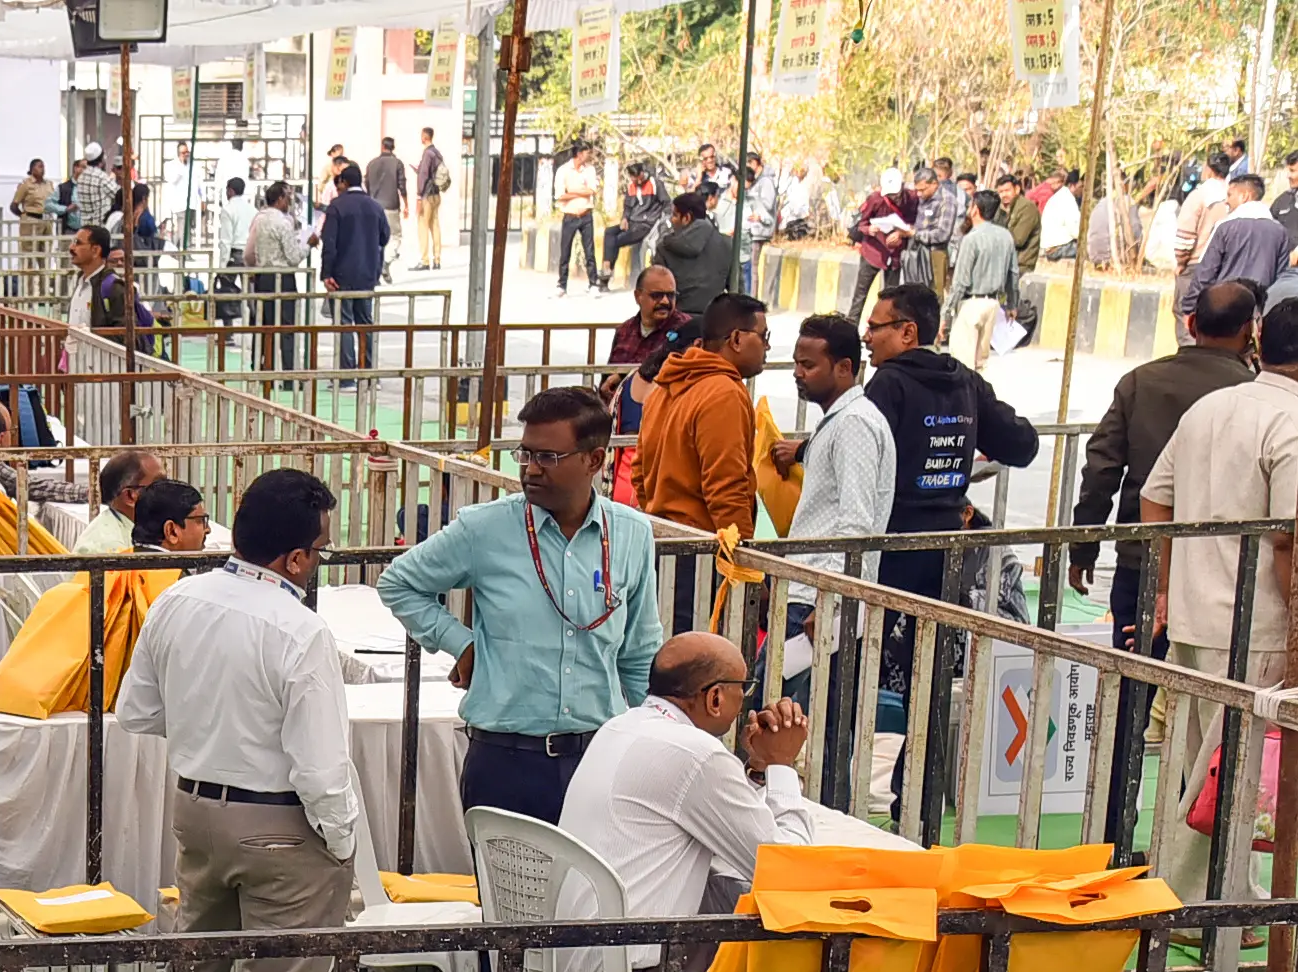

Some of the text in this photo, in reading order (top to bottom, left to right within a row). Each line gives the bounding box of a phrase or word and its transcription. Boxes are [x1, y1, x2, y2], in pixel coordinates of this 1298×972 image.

[930, 435, 965, 448] THINK IT
[925, 457, 963, 470] BUILD IT
[921, 474, 963, 486] TRADE IT
[1063, 664, 1082, 782] राज्य निवडणूक आयोग
